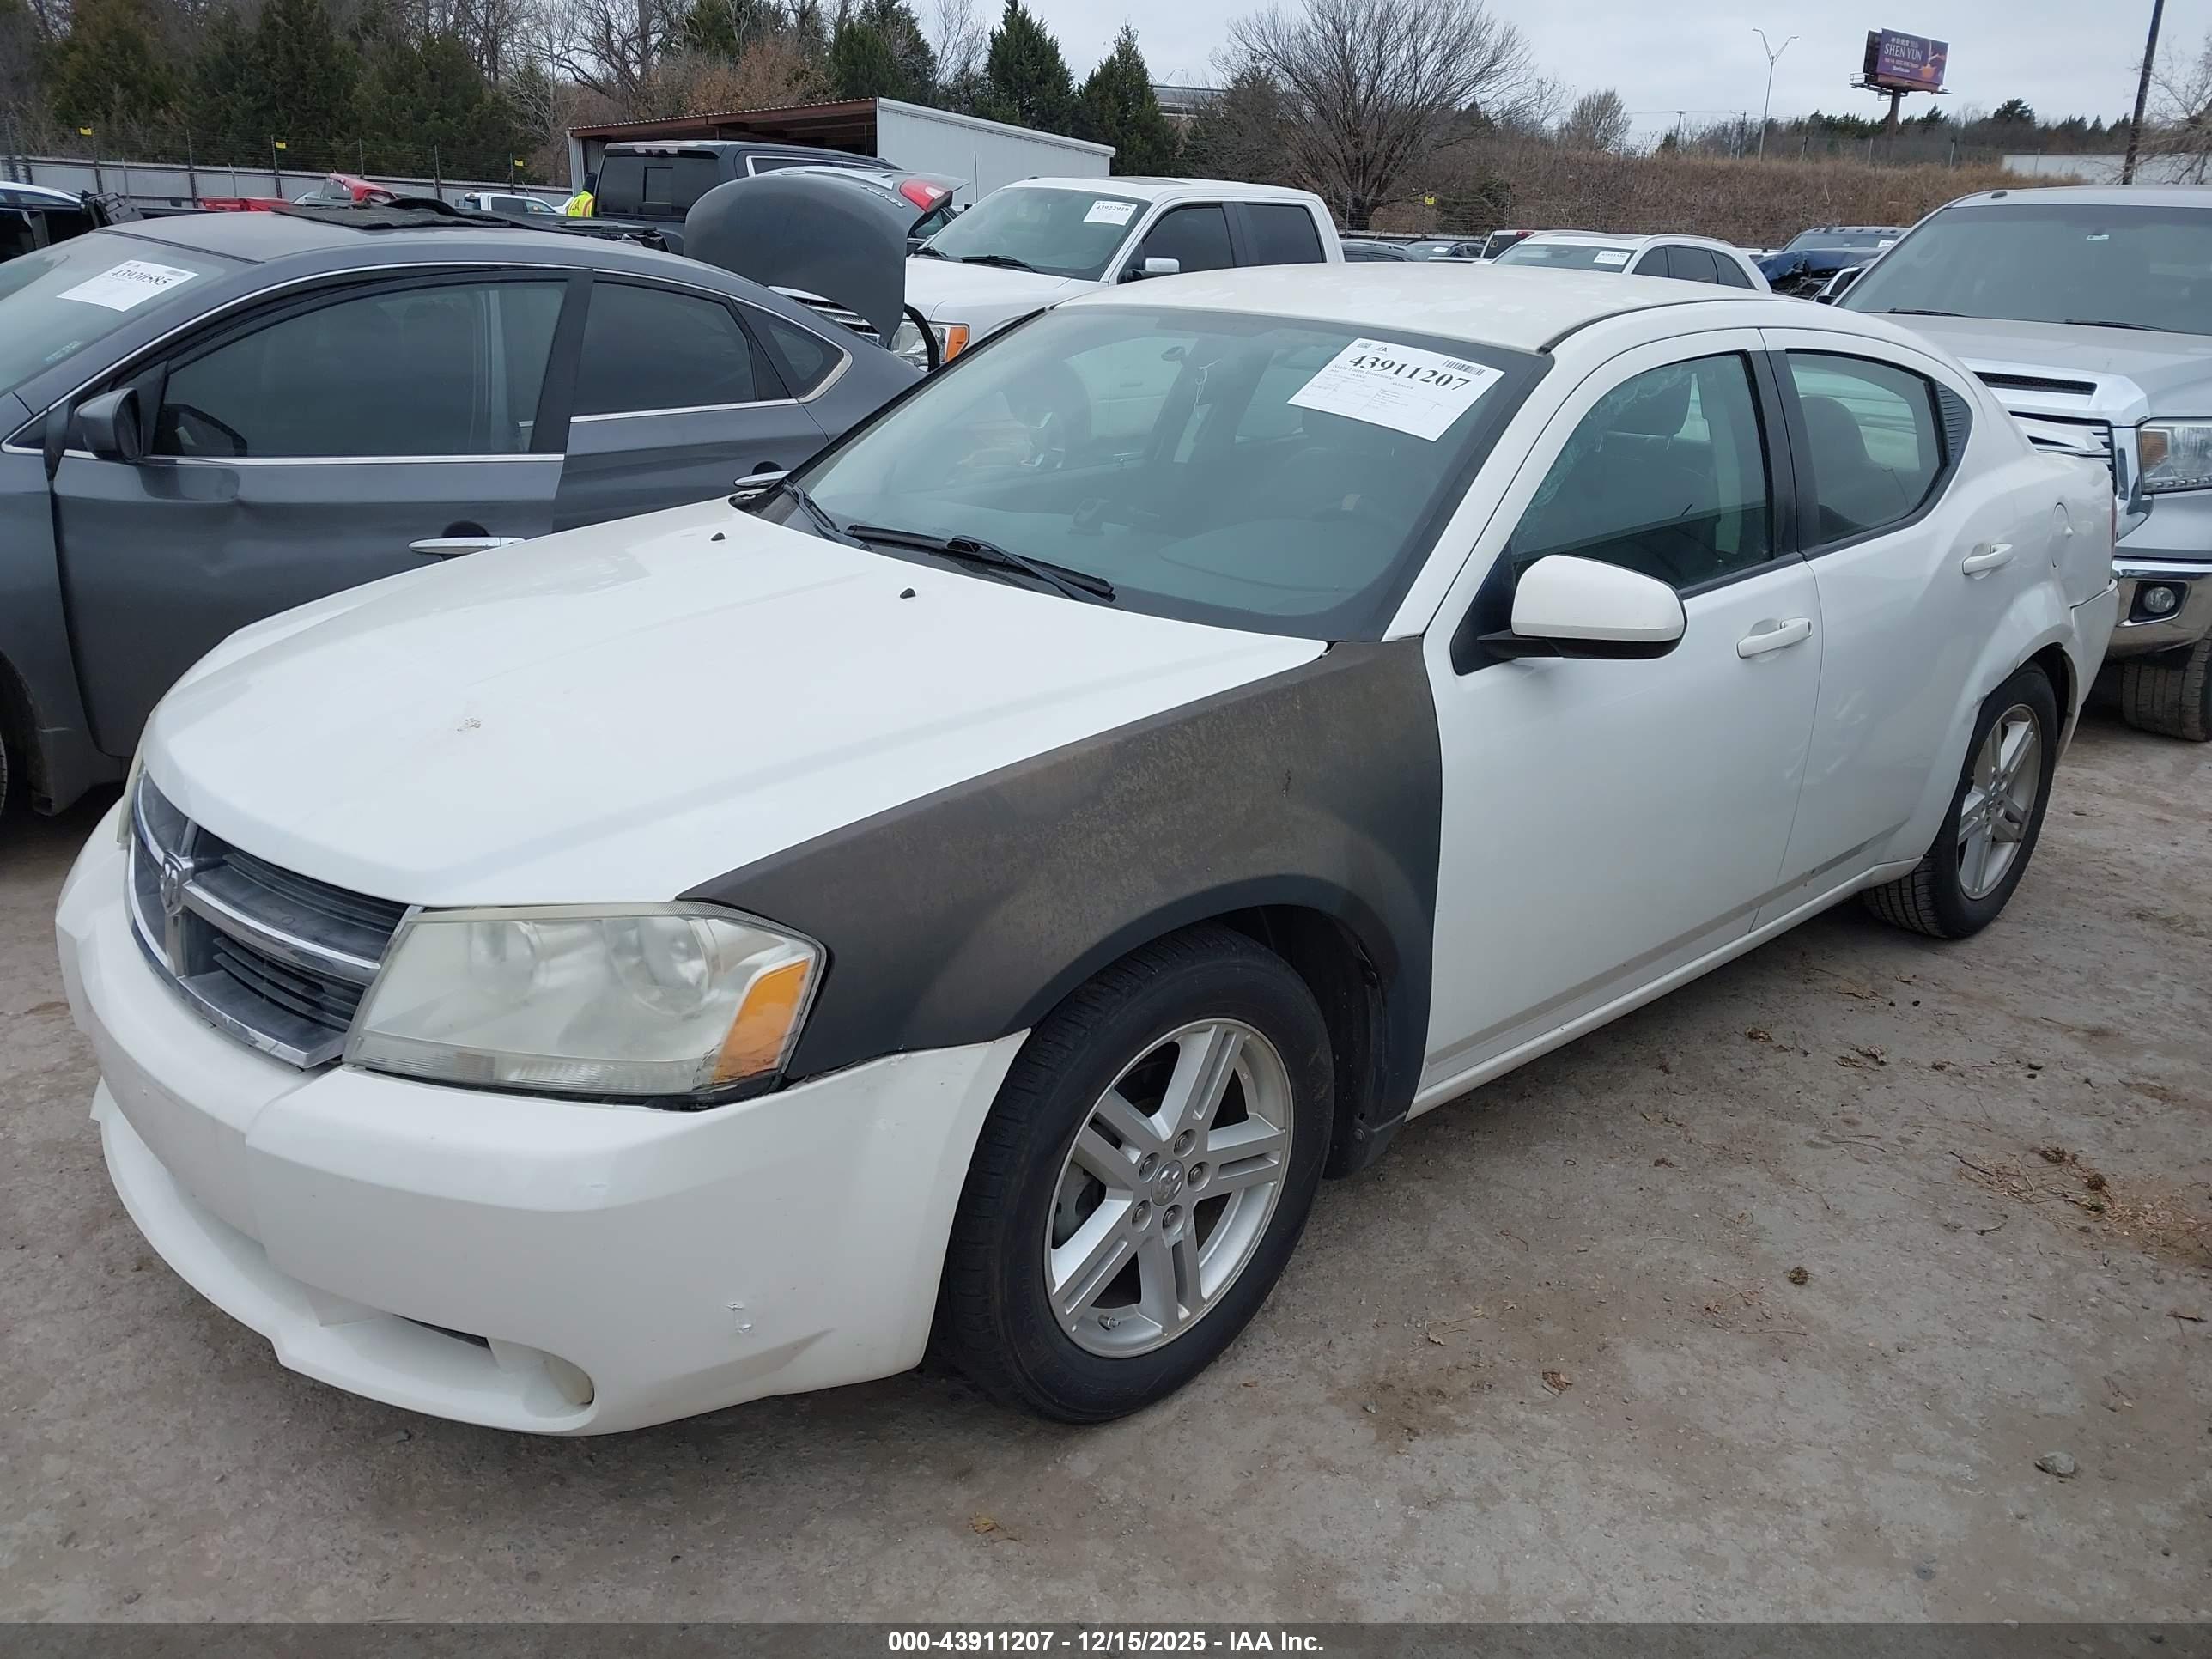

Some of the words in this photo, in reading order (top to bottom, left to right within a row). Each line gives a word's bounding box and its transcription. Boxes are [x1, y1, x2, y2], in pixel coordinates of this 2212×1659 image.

[1884, 43, 1906, 58] SHEN
[1907, 47, 1923, 61] YUN
[1348, 355, 1471, 391] 43911207
